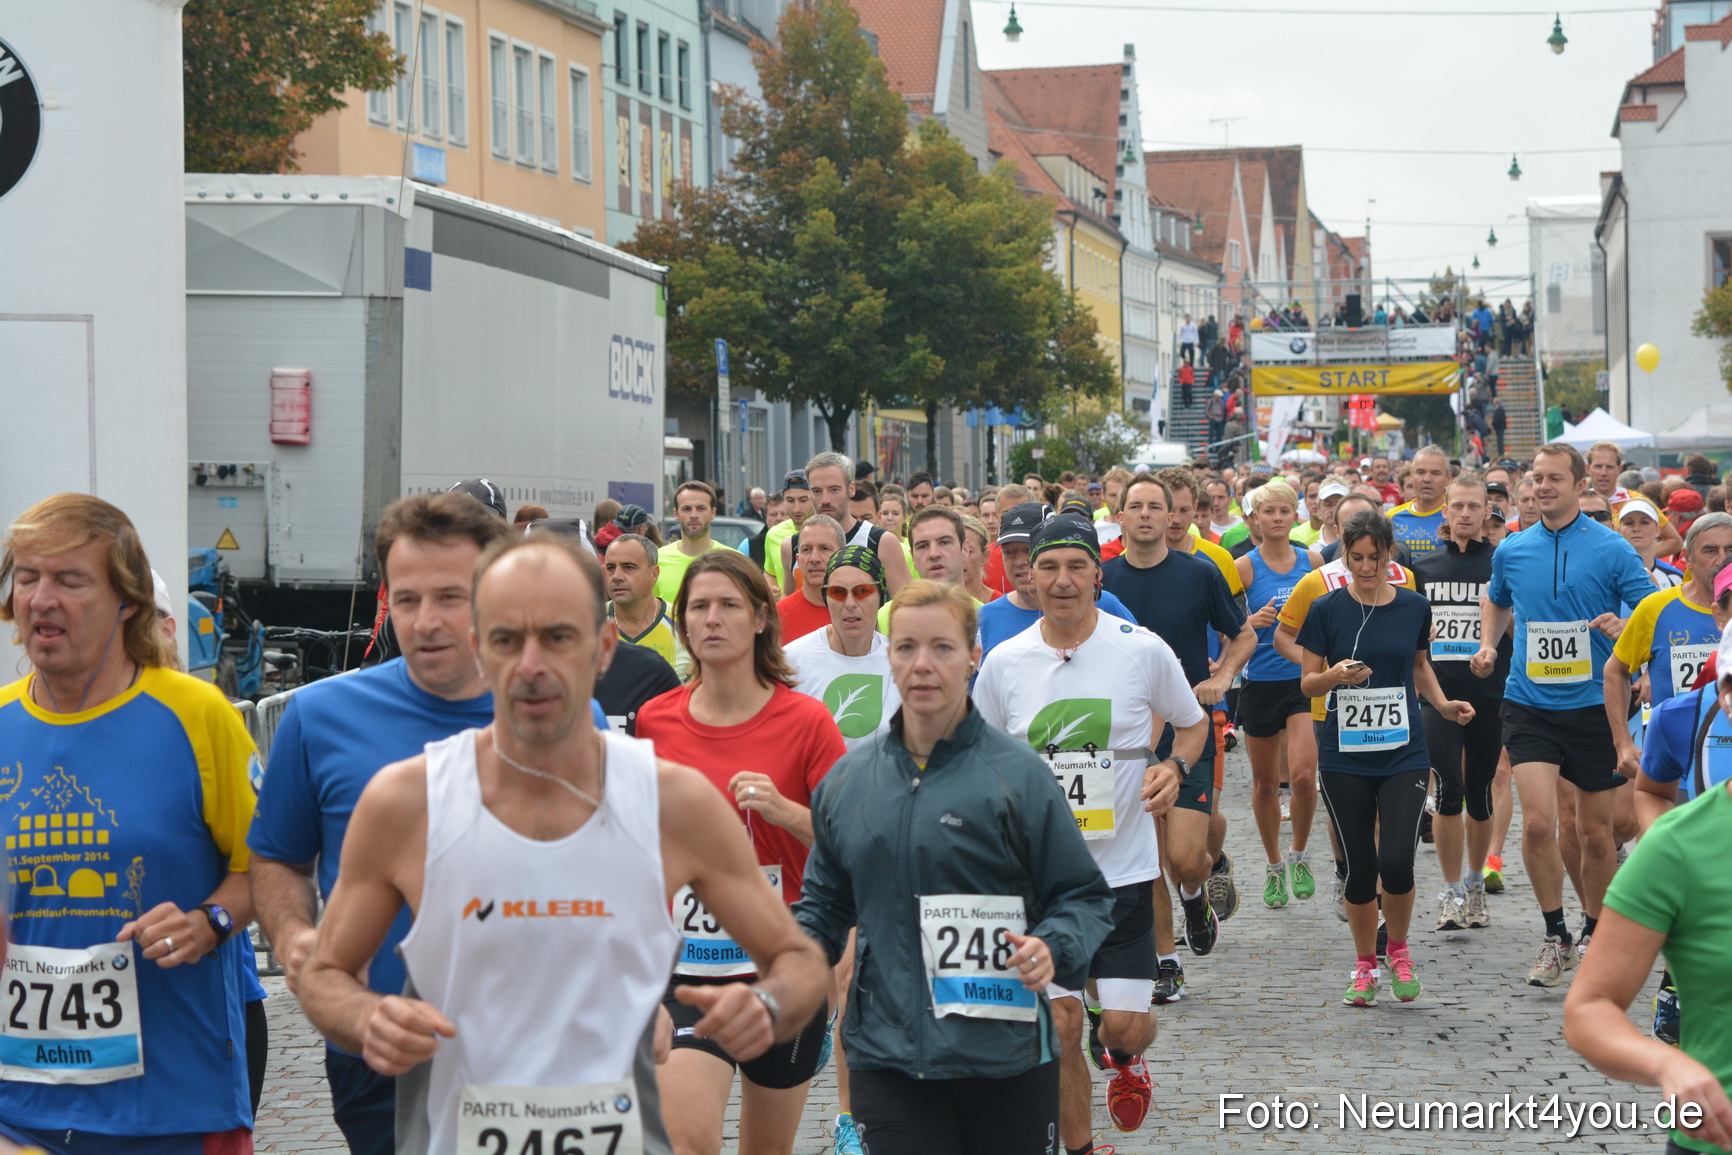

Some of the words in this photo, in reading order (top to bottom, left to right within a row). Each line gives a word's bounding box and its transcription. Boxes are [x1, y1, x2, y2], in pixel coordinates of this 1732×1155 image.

[608, 334, 655, 404] BOCK
[1319, 370, 1391, 388] START
[1436, 619, 1482, 640] 2678
[1527, 627, 1546, 635] PARTL
[1547, 626, 1578, 635] Neumarkt
[1443, 644, 1472, 653] Markus
[1537, 636, 1578, 660] 304
[1672, 651, 1698, 660] PARTL
[1544, 665, 1572, 675] Simon
[1363, 694, 1395, 702] Neumarkt
[1345, 703, 1402, 728] 2475
[1362, 733, 1385, 743] Julia
[1054, 761, 1097, 770] Neumarkt
[84, 852, 110, 861] 2014
[502, 900, 615, 917] KLEBL
[924, 907, 968, 919] PARTL
[971, 908, 1026, 921] Neumarkt
[36, 960, 106, 975] Neumarkt
[964, 983, 1014, 1001] Marika
[8, 979, 123, 1031] 2743
[35, 1044, 92, 1064] Achim
[463, 1102, 520, 1118] PARTL
[525, 1100, 608, 1119] Neumarkt
